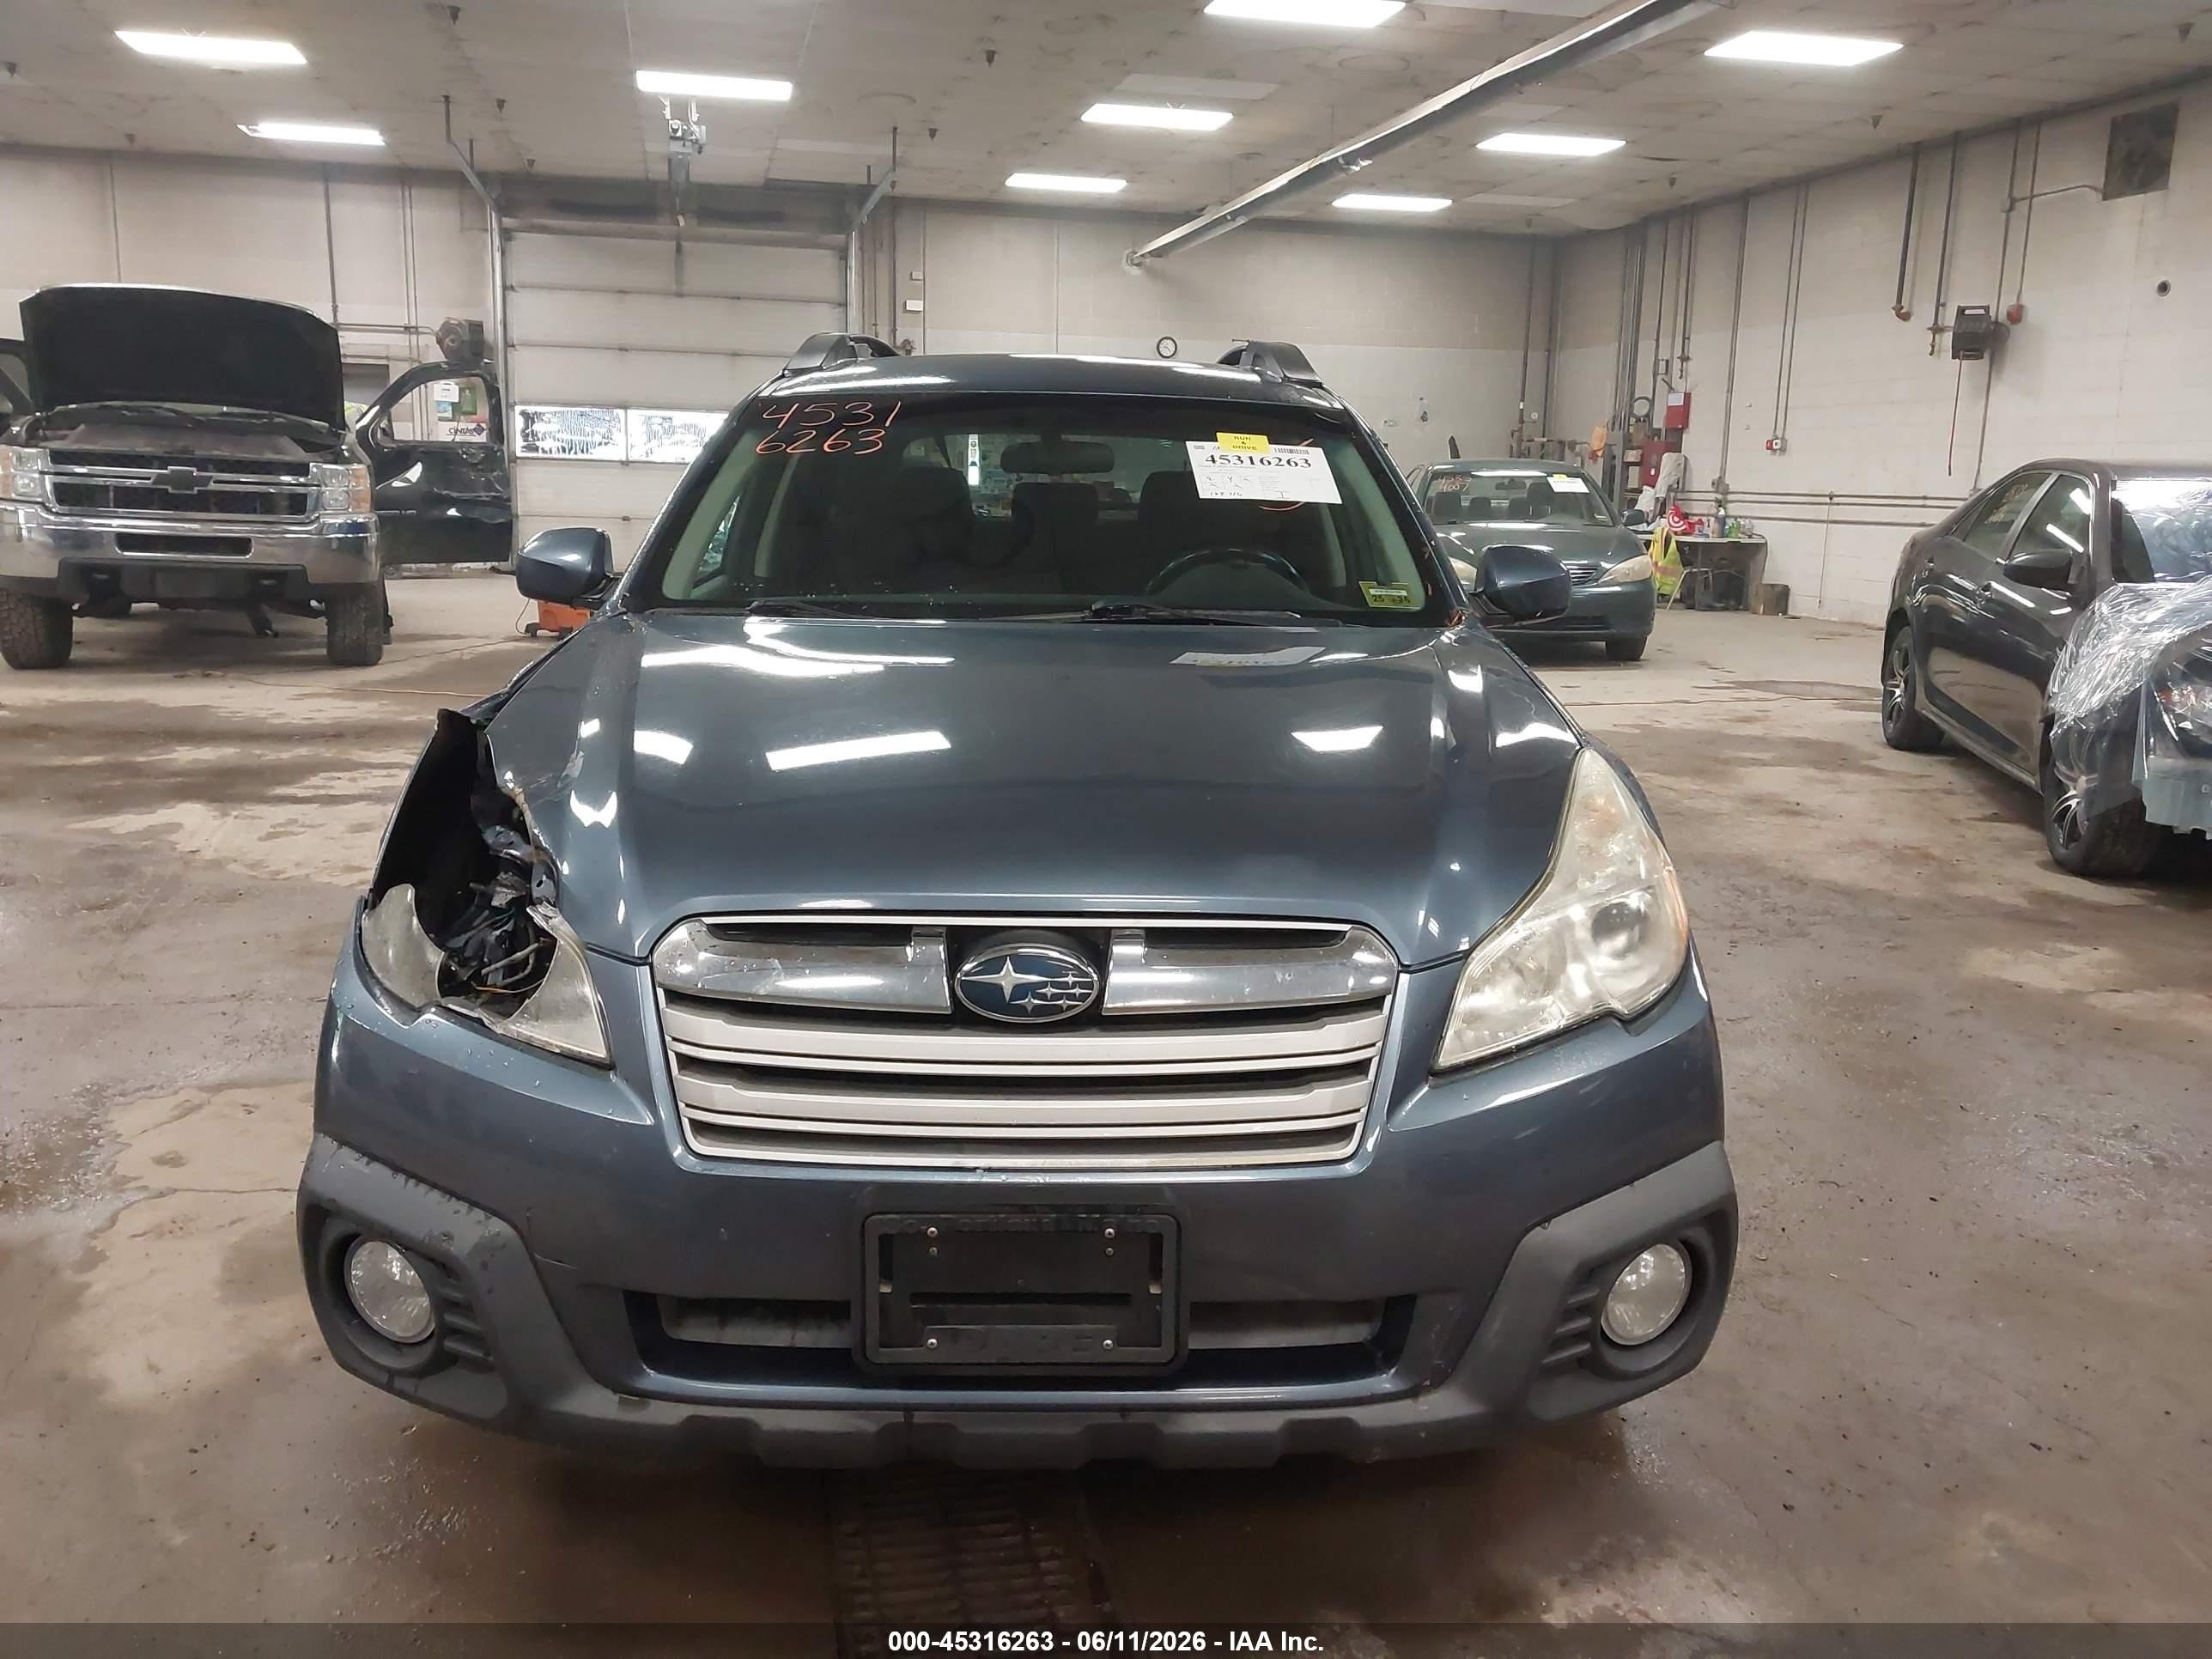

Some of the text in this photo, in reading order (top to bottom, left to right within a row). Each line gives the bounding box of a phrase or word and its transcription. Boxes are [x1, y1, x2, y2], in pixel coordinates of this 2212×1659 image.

[762, 400, 902, 428] 4531
[756, 428, 887, 454] 6263
[1205, 454, 1312, 469] 45316263
